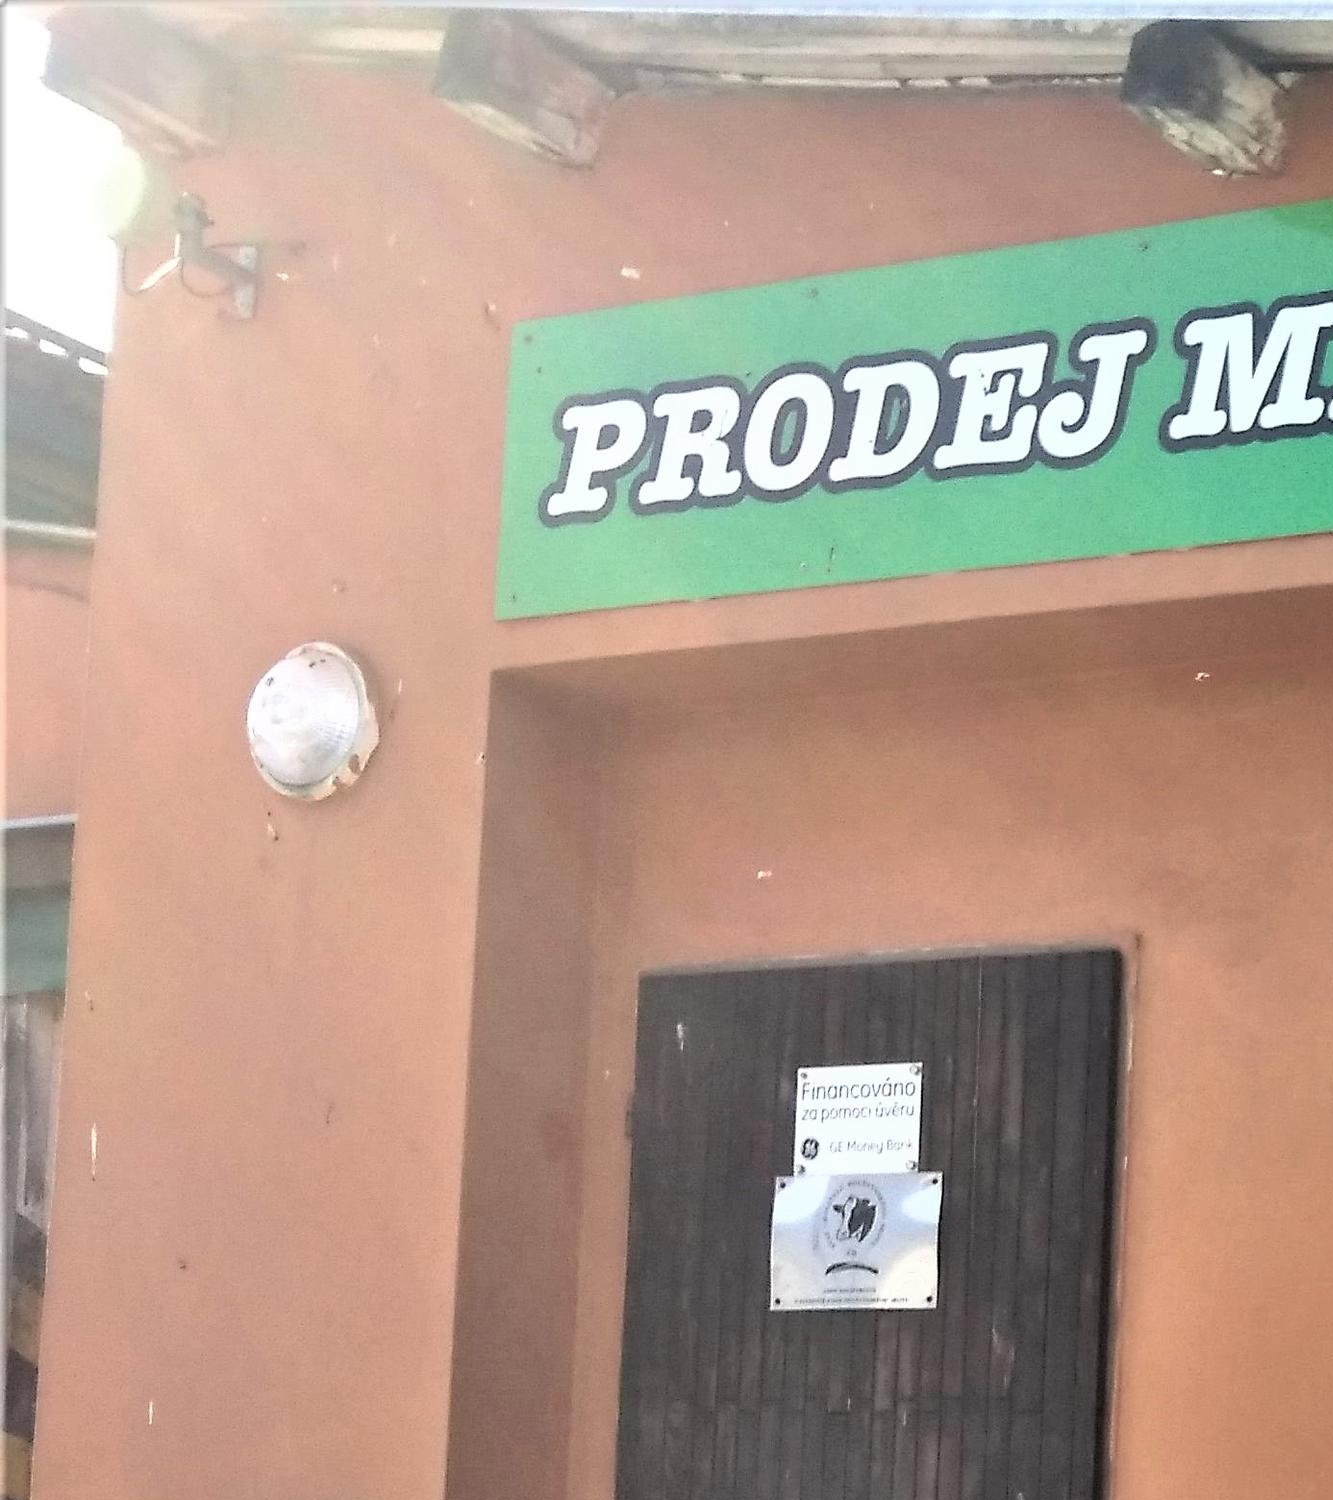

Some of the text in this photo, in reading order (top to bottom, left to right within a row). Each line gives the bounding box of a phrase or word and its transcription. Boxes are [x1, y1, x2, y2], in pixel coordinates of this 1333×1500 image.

[539, 318, 1157, 527] PRODEJ
[802, 1077, 916, 1100] Financováno
[802, 1109, 817, 1121] za
[876, 1102, 914, 1118] úvěru
